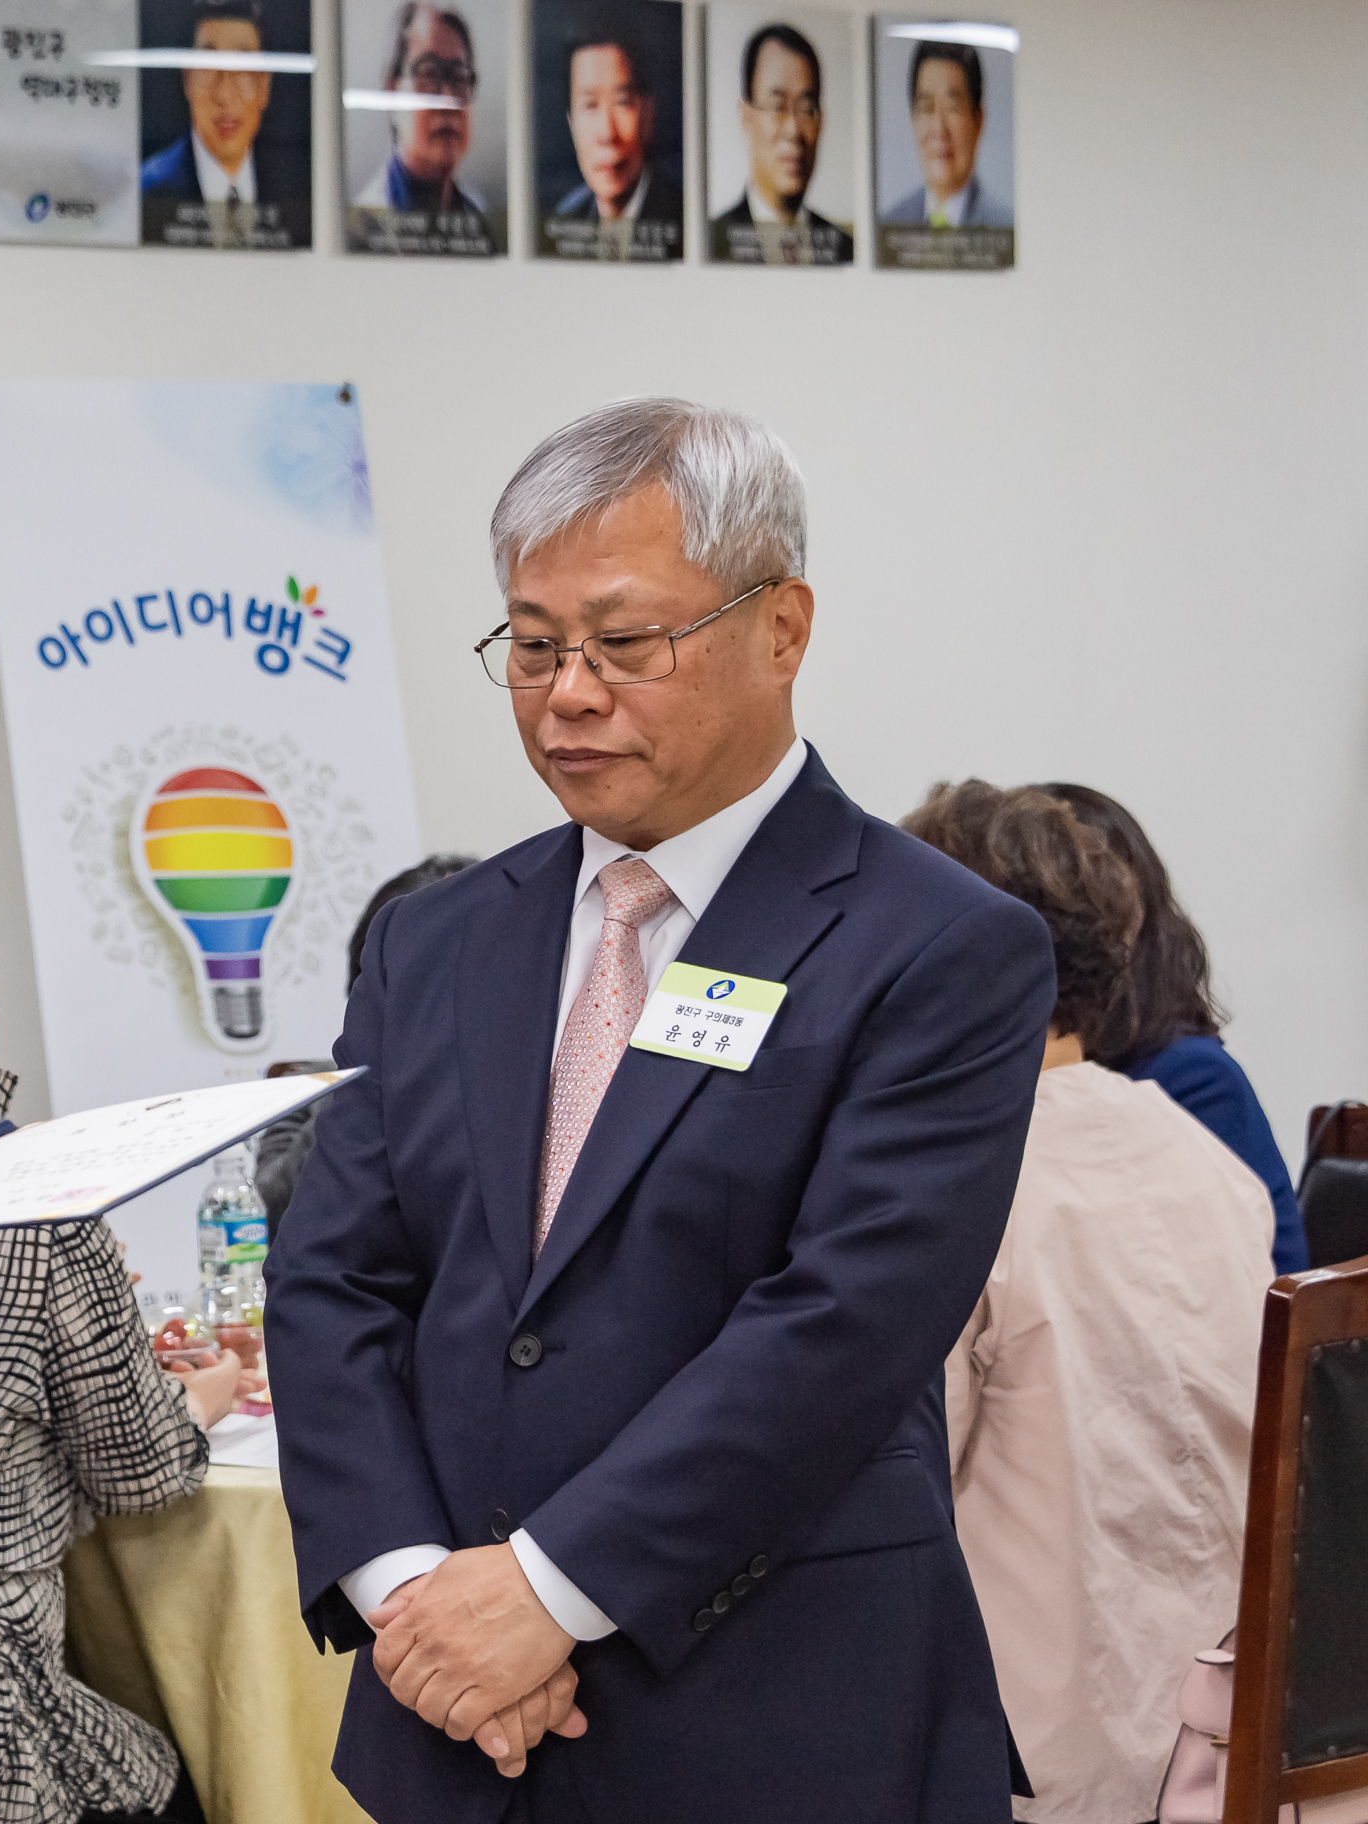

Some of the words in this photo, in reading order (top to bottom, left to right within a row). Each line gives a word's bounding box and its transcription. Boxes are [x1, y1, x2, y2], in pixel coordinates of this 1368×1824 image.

[37, 589, 353, 683] 아이디어뱅크
[675, 1004, 702, 1018] 광진구
[705, 1010, 744, 1027] 구의제3동
